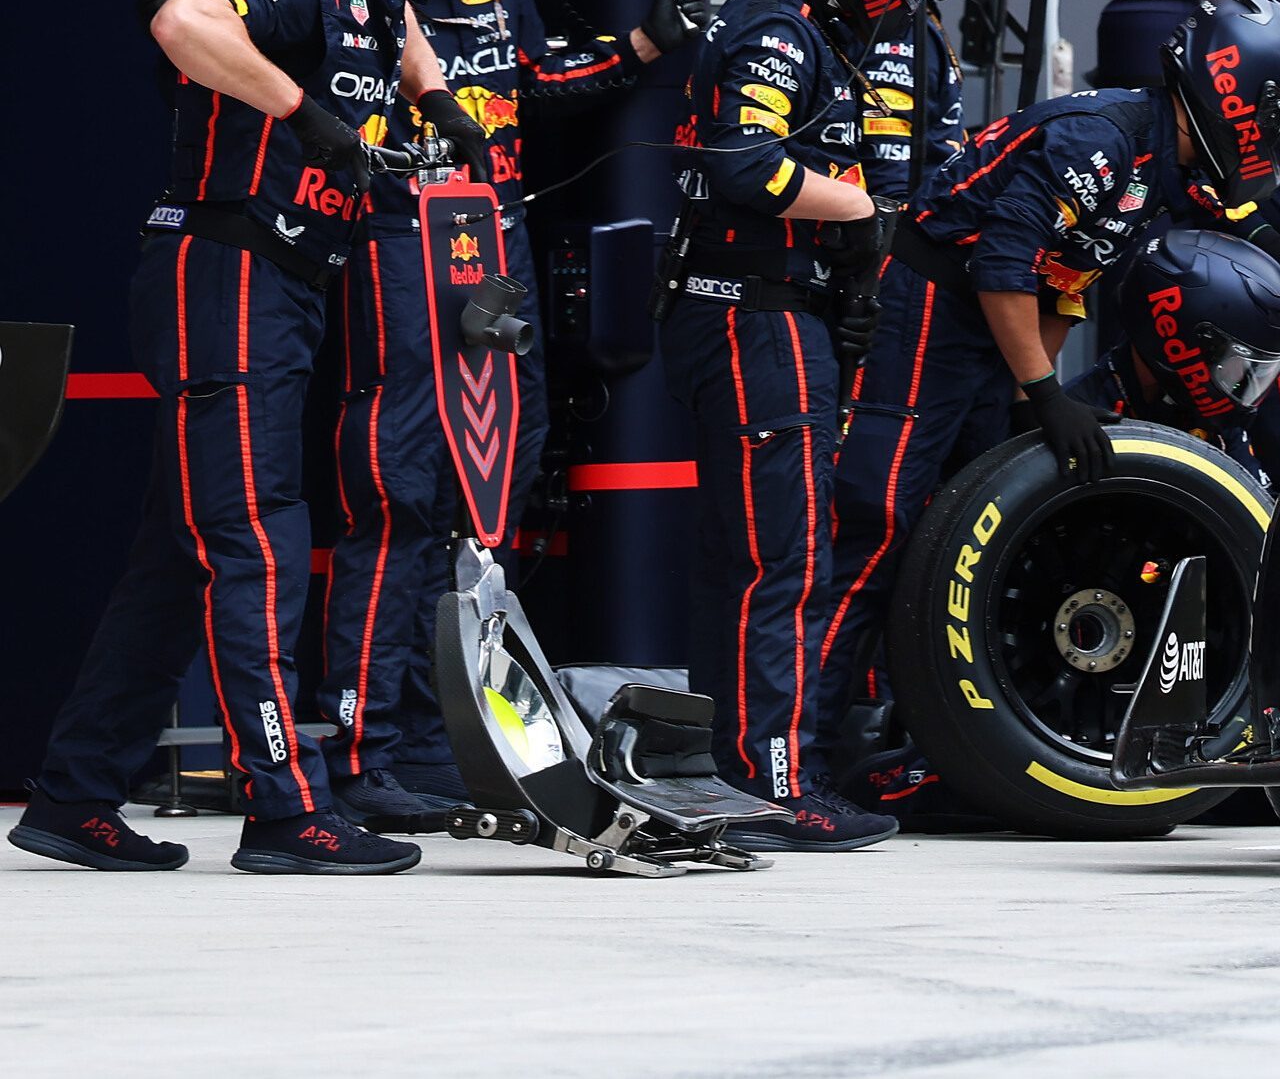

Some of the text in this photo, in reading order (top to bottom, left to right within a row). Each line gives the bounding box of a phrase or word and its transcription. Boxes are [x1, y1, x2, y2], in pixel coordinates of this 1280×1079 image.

[761, 35, 805, 65] Mobil
[762, 56, 793, 77] AVA
[874, 41, 914, 59] Mobi
[878, 60, 910, 74] AVA
[746, 61, 800, 93] TRADE
[1204, 43, 1260, 122] Red
[1089, 150, 1116, 193] Mobil
[149, 205, 186, 223] parco
[1147, 285, 1236, 417] Red Bull
[946, 499, 1004, 710] P ZERO
[259, 699, 288, 763] sparco
[770, 736, 791, 799] sparco
